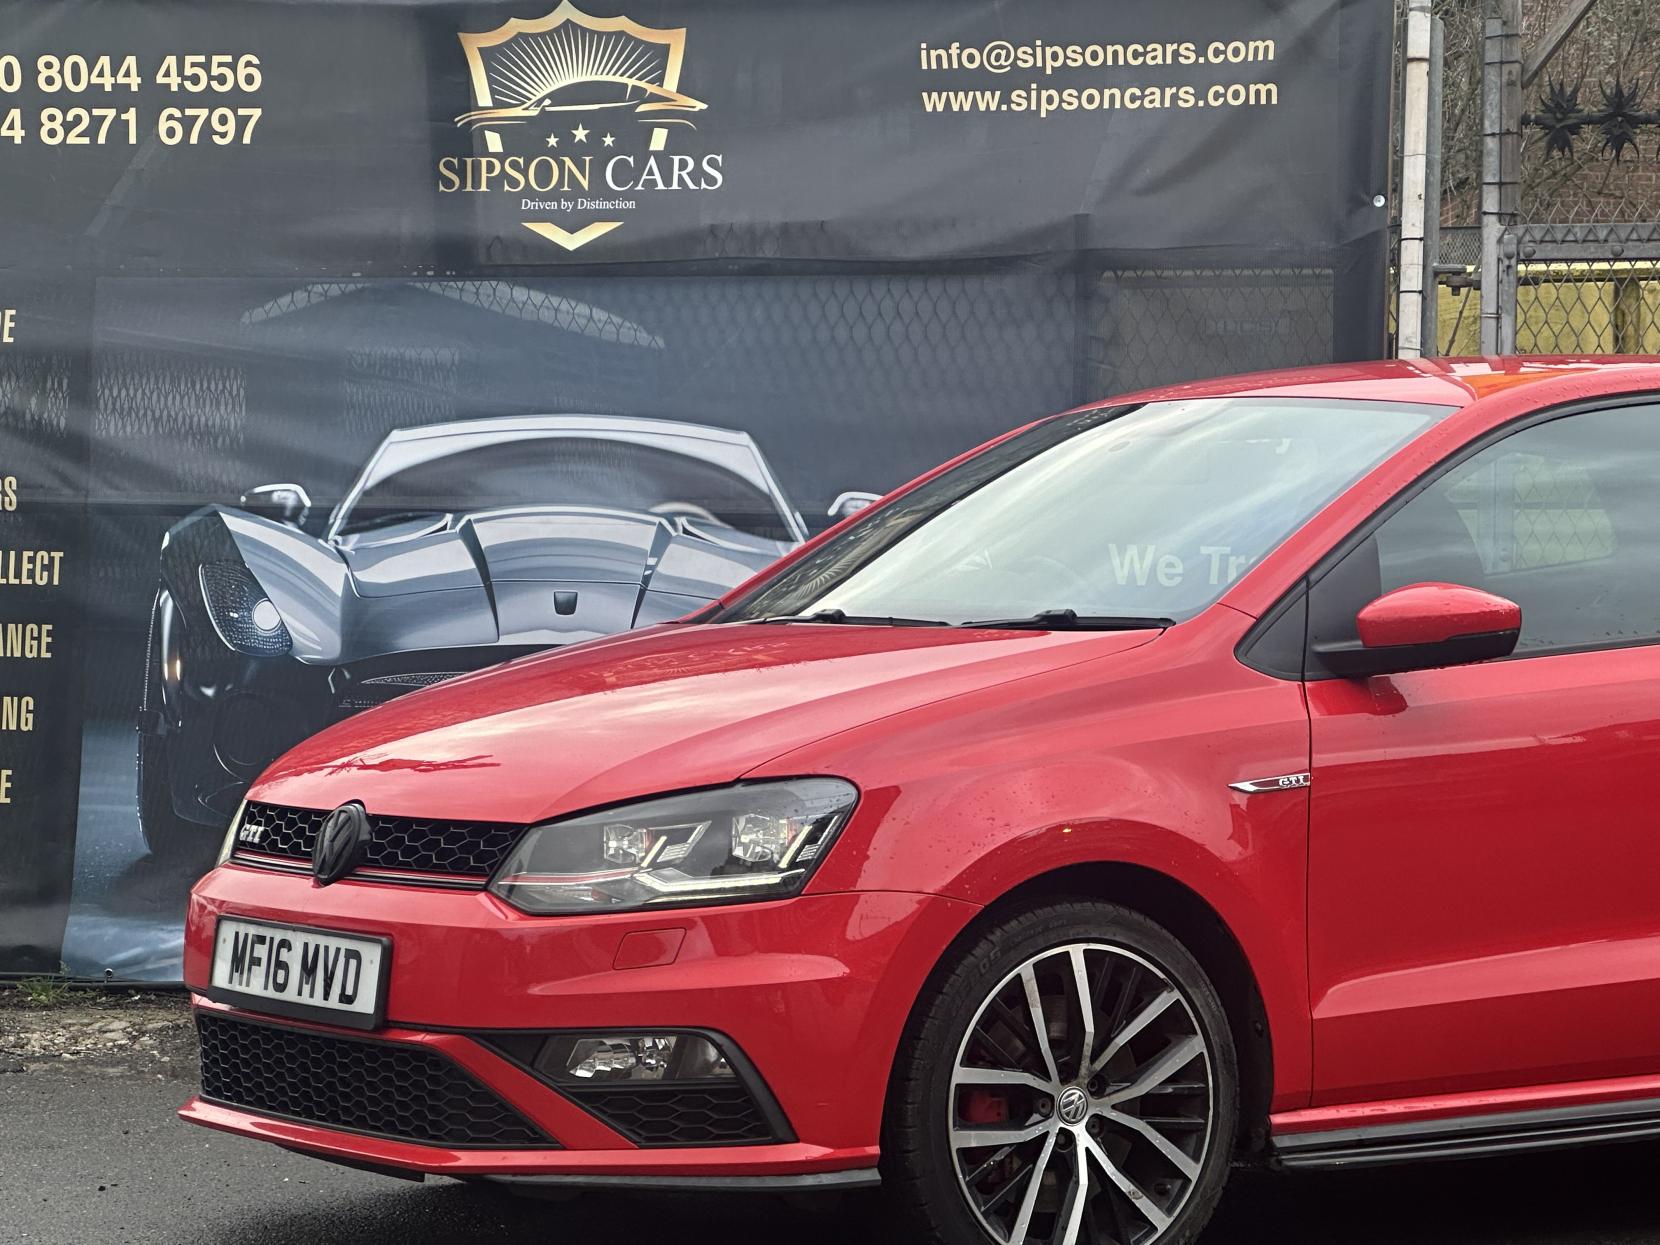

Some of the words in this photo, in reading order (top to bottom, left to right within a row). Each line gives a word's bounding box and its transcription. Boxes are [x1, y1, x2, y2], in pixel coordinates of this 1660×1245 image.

[37, 54, 142, 93] 8044
[156, 53, 262, 93] 4556
[920, 39, 1275, 74] info@sipsoncars.com
[922, 82, 1279, 118] www.sipsoncars.com
[39, 107, 137, 145] 8271
[158, 107, 262, 145] 6797
[438, 156, 593, 193] SIPSON
[605, 154, 723, 191] CARS
[520, 198, 558, 210] Driven
[561, 198, 574, 212] by
[577, 198, 636, 210] Distinction
[1108, 543, 1184, 587] We
[1200, 546, 1259, 585] Tr
[1278, 775, 1305, 787] GTI
[240, 823, 265, 844] GTI
[228, 931, 292, 993] MF16
[297, 942, 362, 1005] MVD
